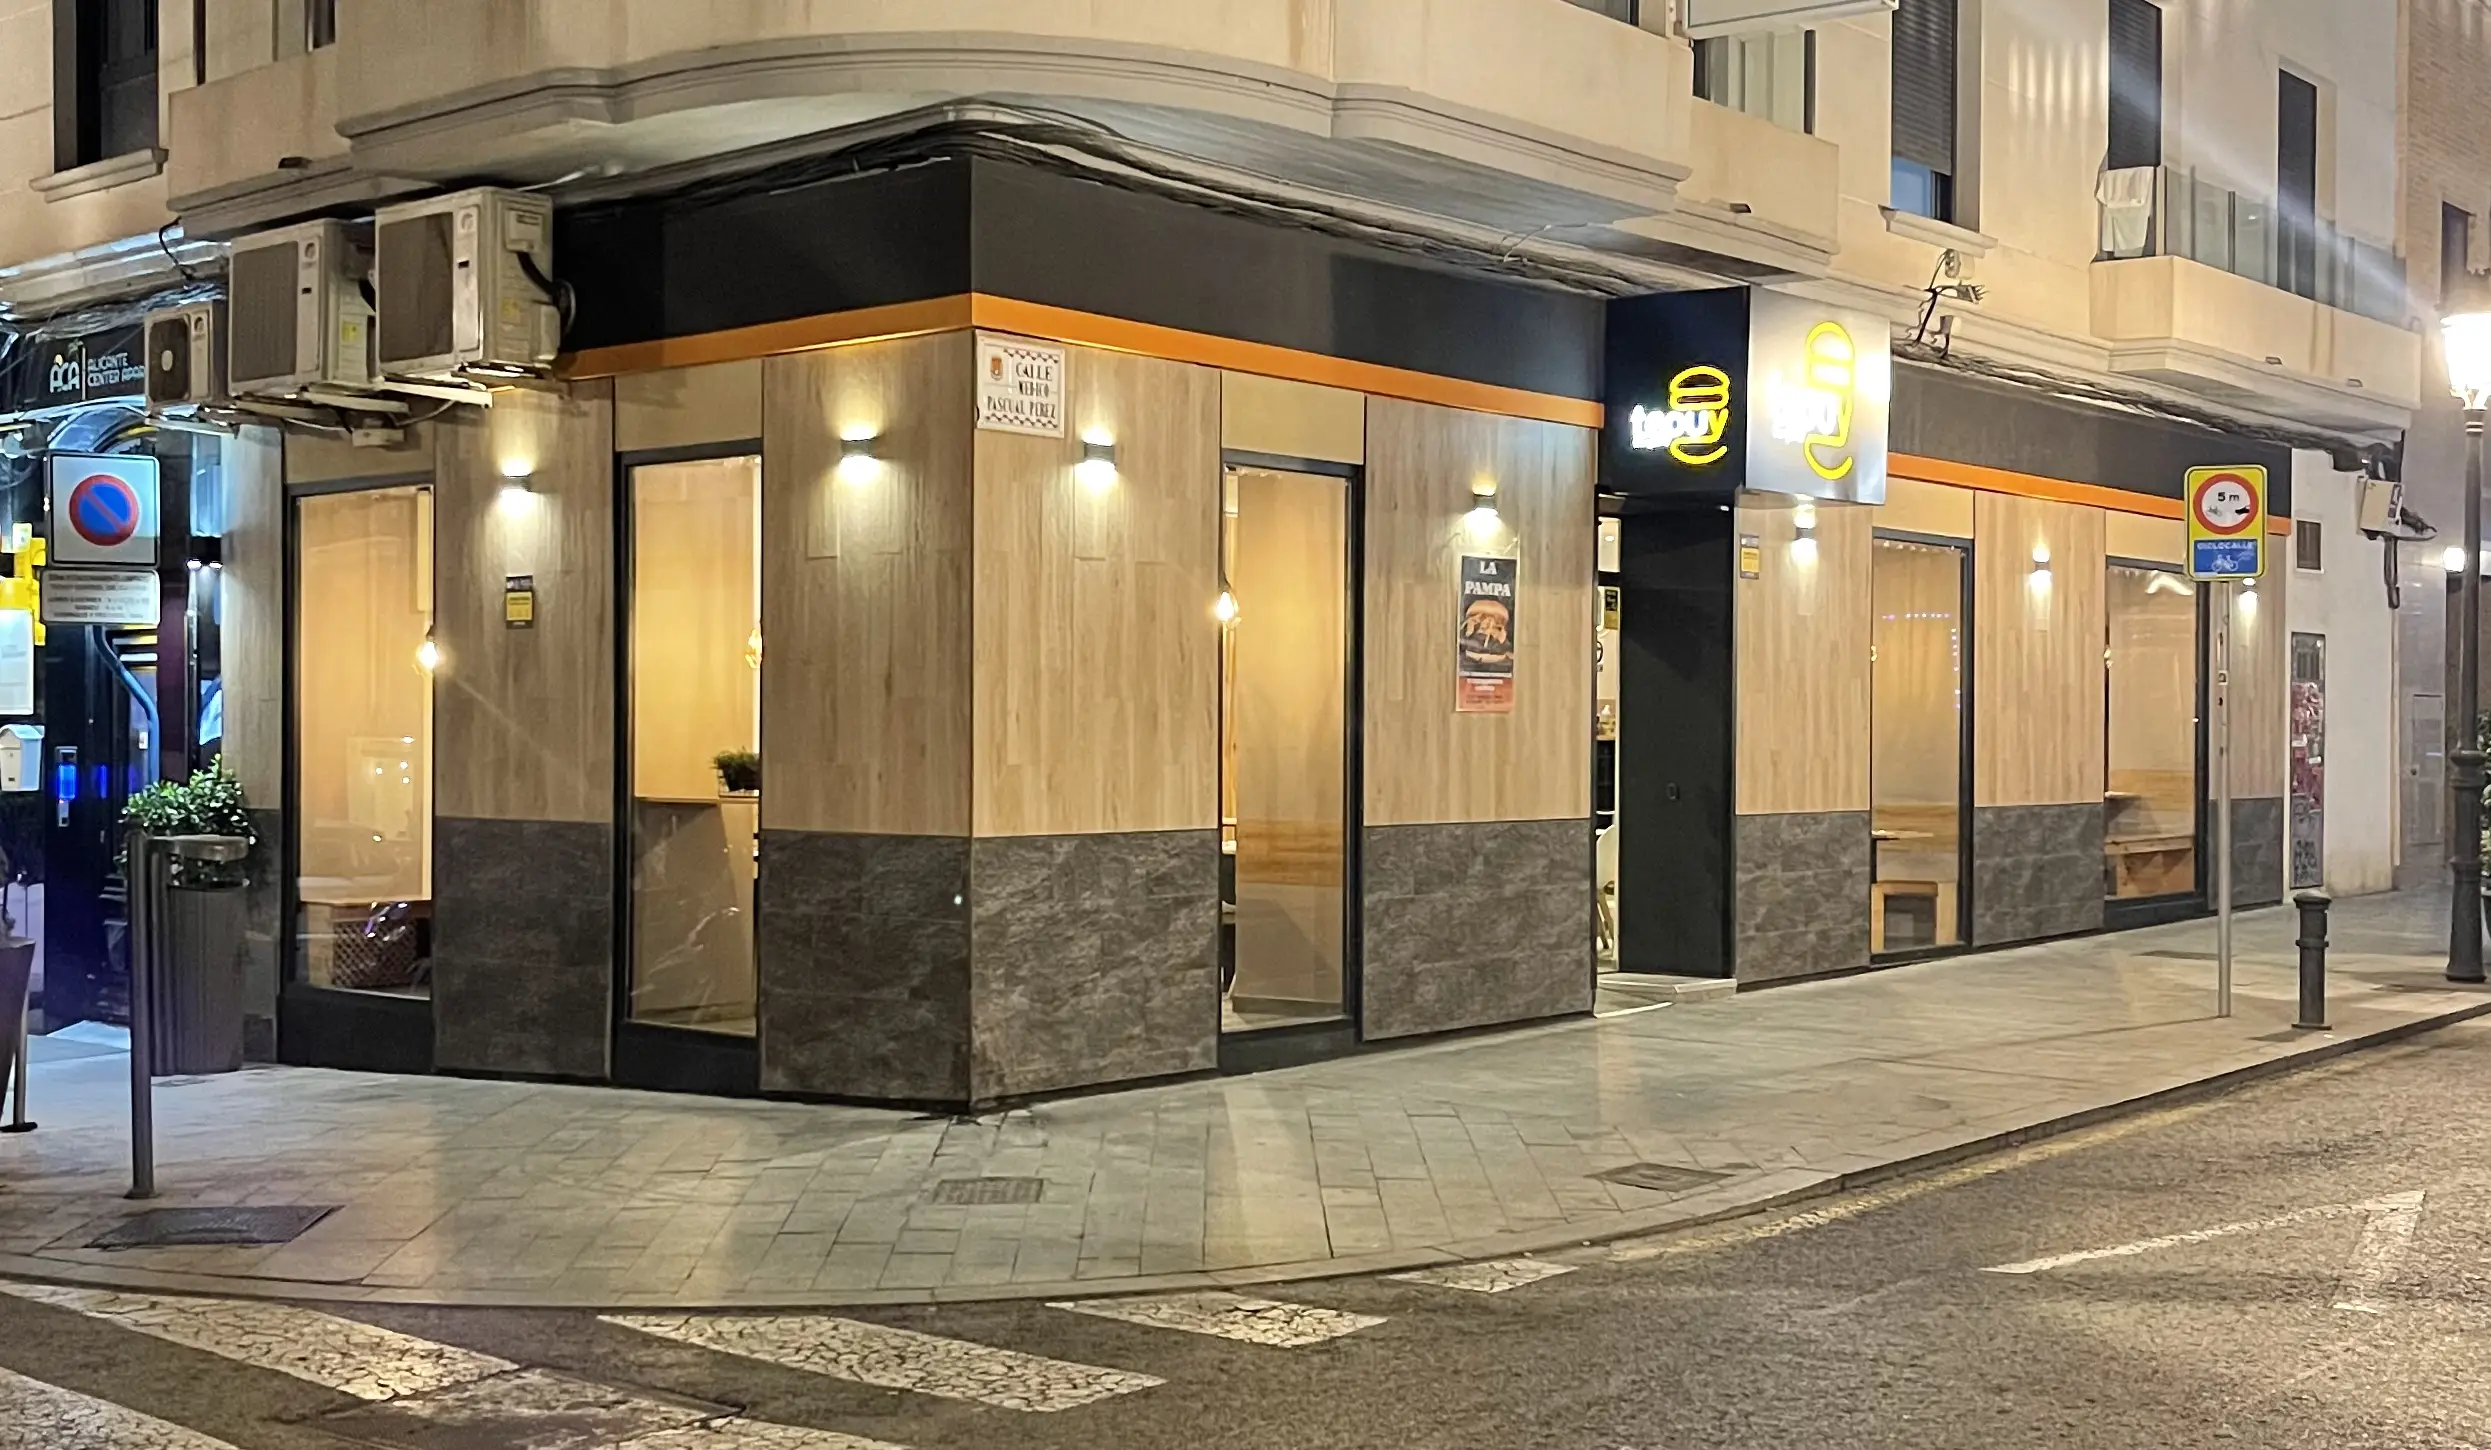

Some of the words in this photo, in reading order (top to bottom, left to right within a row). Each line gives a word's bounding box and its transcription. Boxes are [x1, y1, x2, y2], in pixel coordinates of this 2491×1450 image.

[1016, 362, 1053, 382] CALLE
[2217, 491, 2226, 502] 5
[2228, 493, 2240, 502] m
[1479, 561, 1497, 575] LA
[1464, 580, 1511, 597] PAMPA
